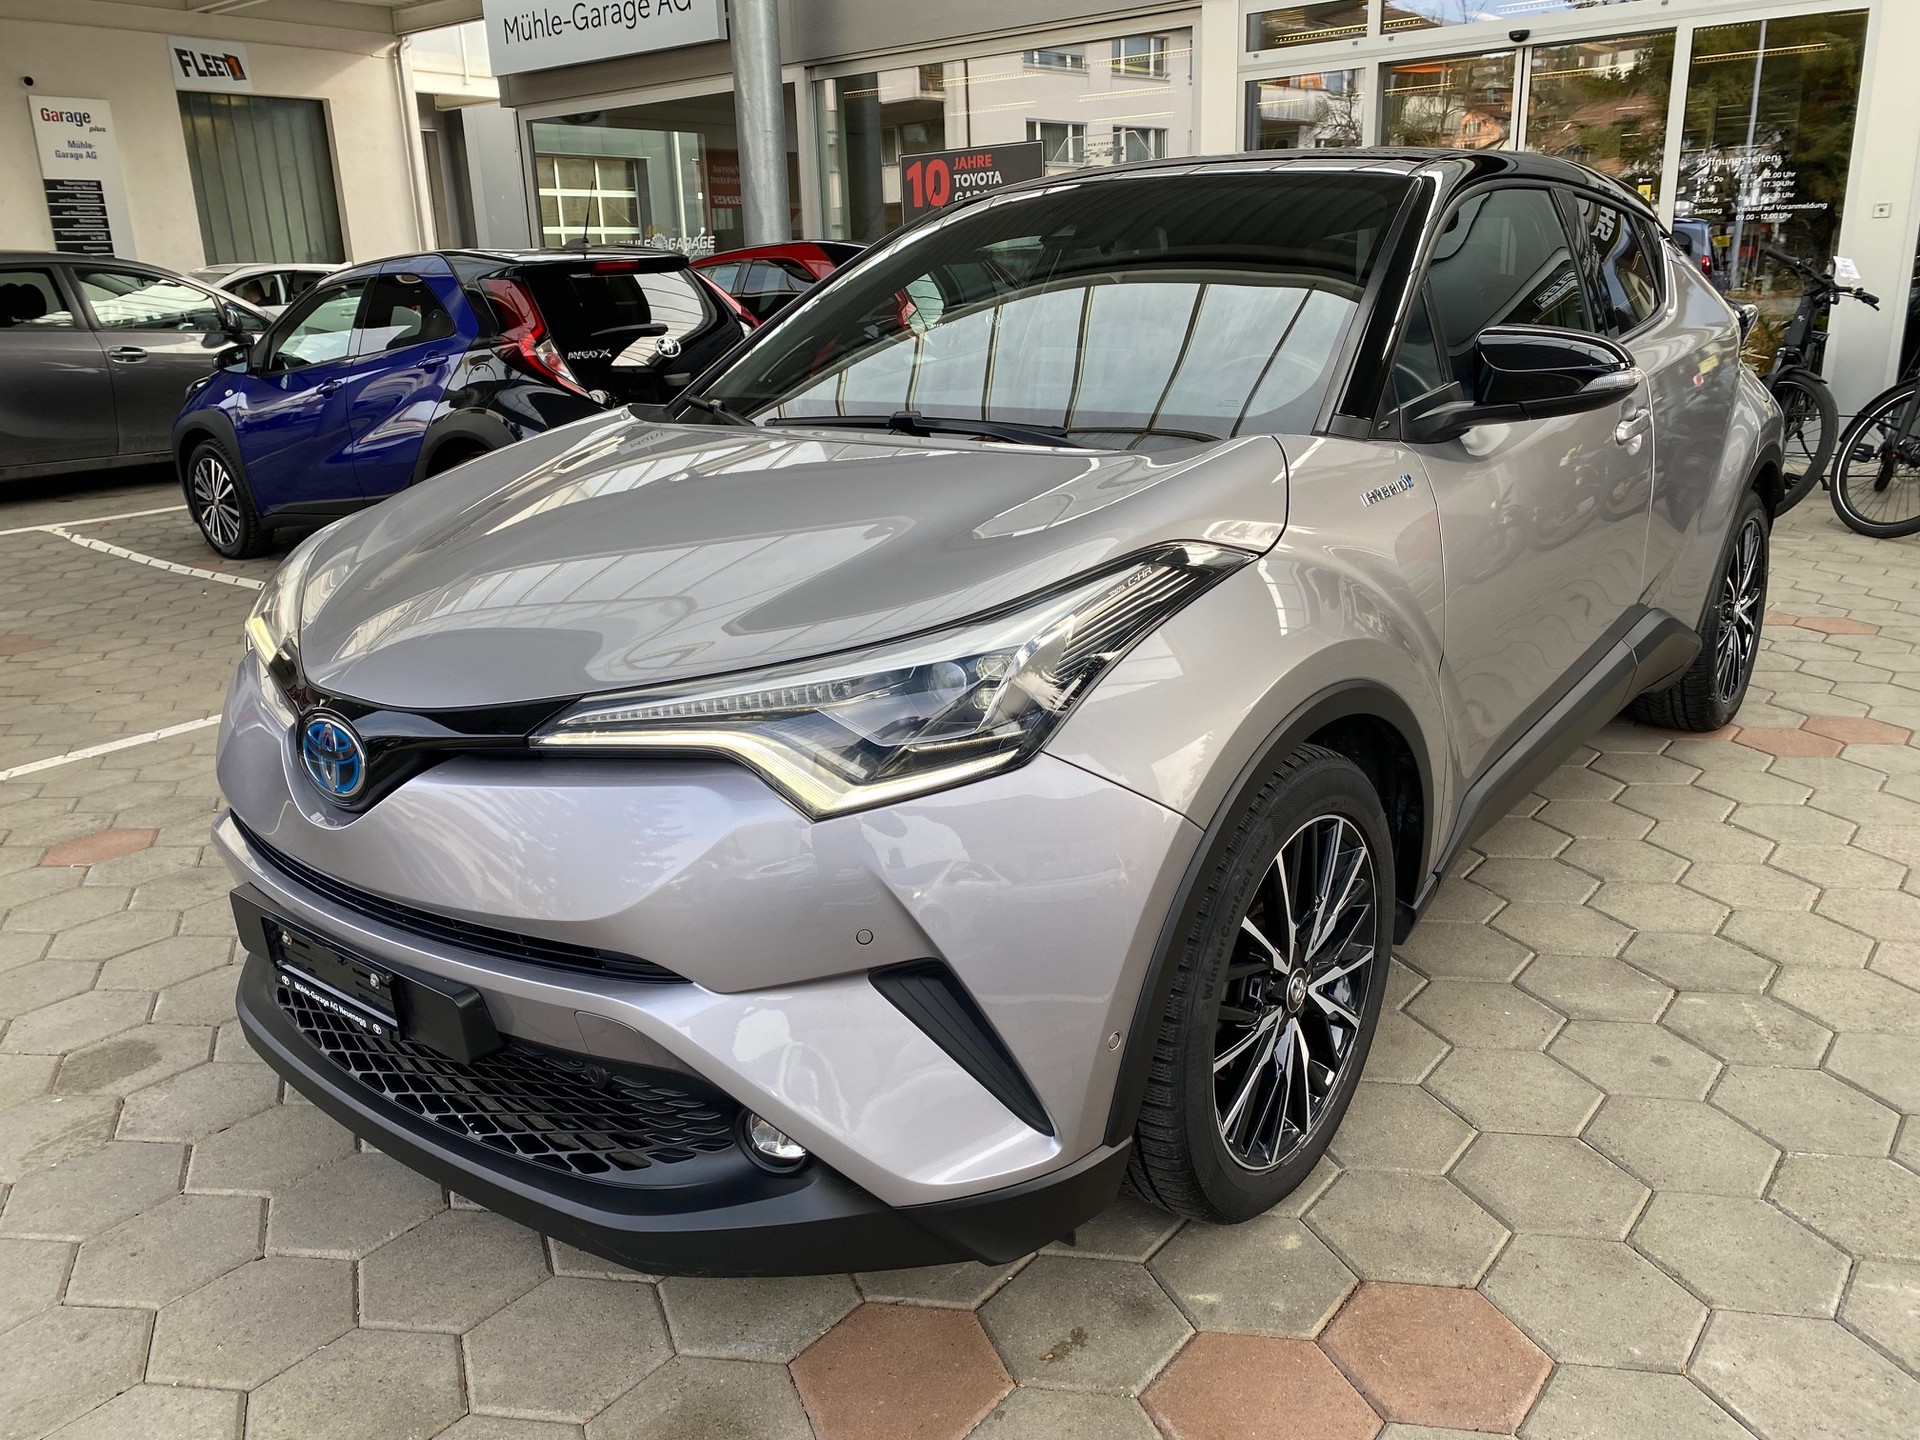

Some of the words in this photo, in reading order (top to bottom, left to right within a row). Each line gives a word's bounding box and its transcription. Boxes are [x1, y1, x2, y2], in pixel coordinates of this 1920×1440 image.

[503, 0, 650, 44] Mühle-Garage
[40, 107, 91, 127] Garage
[89, 125, 106, 133] plus
[67, 140, 96, 149] Mühle-
[55, 149, 83, 160] Garage
[86, 151, 97, 160] AG
[1700, 154, 1783, 167] Öffnungszeiten:
[906, 158, 950, 208] 10
[953, 154, 992, 171] JAHRE
[953, 171, 1002, 188] TOYOTA
[1781, 191, 1795, 199] Uhr
[1737, 204, 1763, 213] Verkauf
[1763, 203, 1775, 211] auf
[1776, 201, 1828, 211] Voranmeldung
[1779, 212, 1793, 220] Uhr
[1361, 480, 1409, 507] HYBRID
[1128, 566, 1154, 587] C-HR
[1202, 868, 1254, 1001] WinterContact
